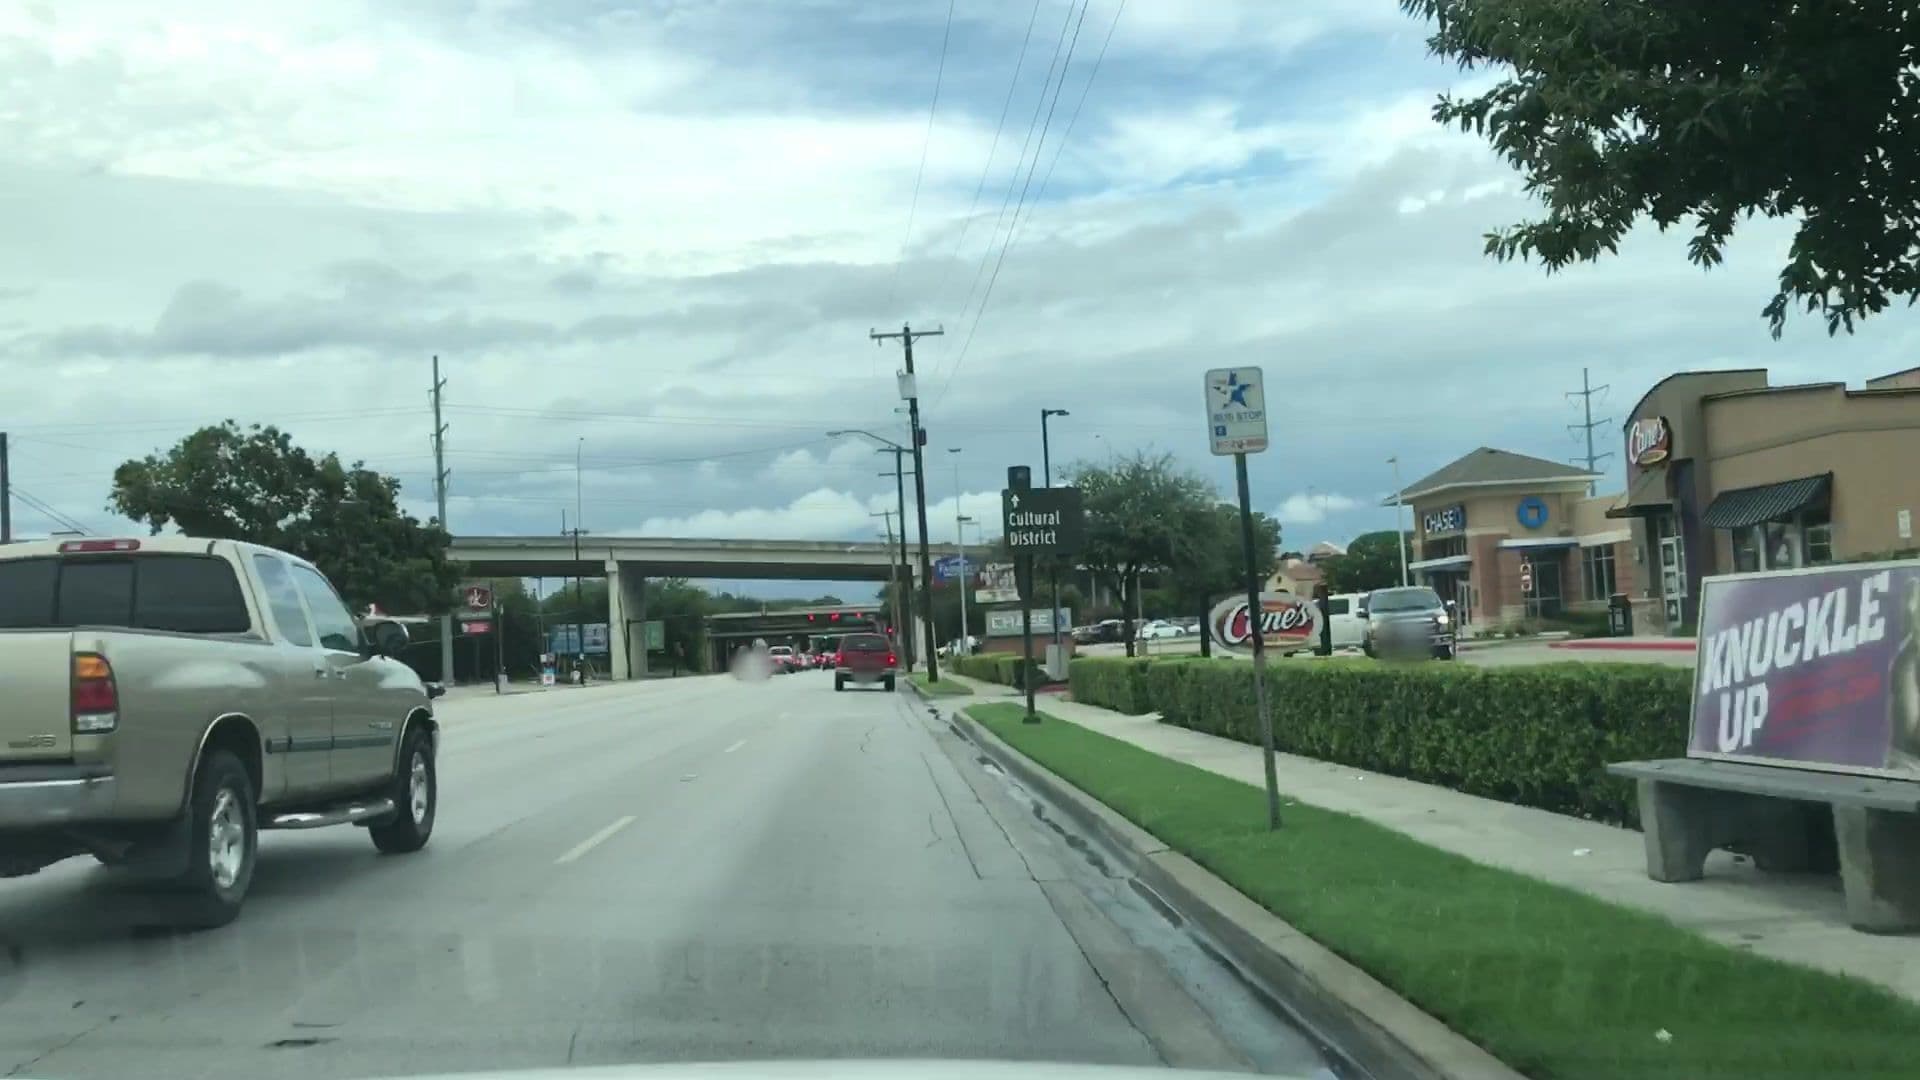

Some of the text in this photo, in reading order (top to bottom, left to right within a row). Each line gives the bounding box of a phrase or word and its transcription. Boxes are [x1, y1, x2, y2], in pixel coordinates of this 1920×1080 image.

[1009, 510, 1060, 526] Cultural
[1424, 509, 1455, 533] CHASE
[1010, 530, 1057, 546] District
[1224, 601, 1309, 644] Cne's
[1702, 571, 1890, 695] KNUCKLE
[1719, 682, 1769, 753] UP
